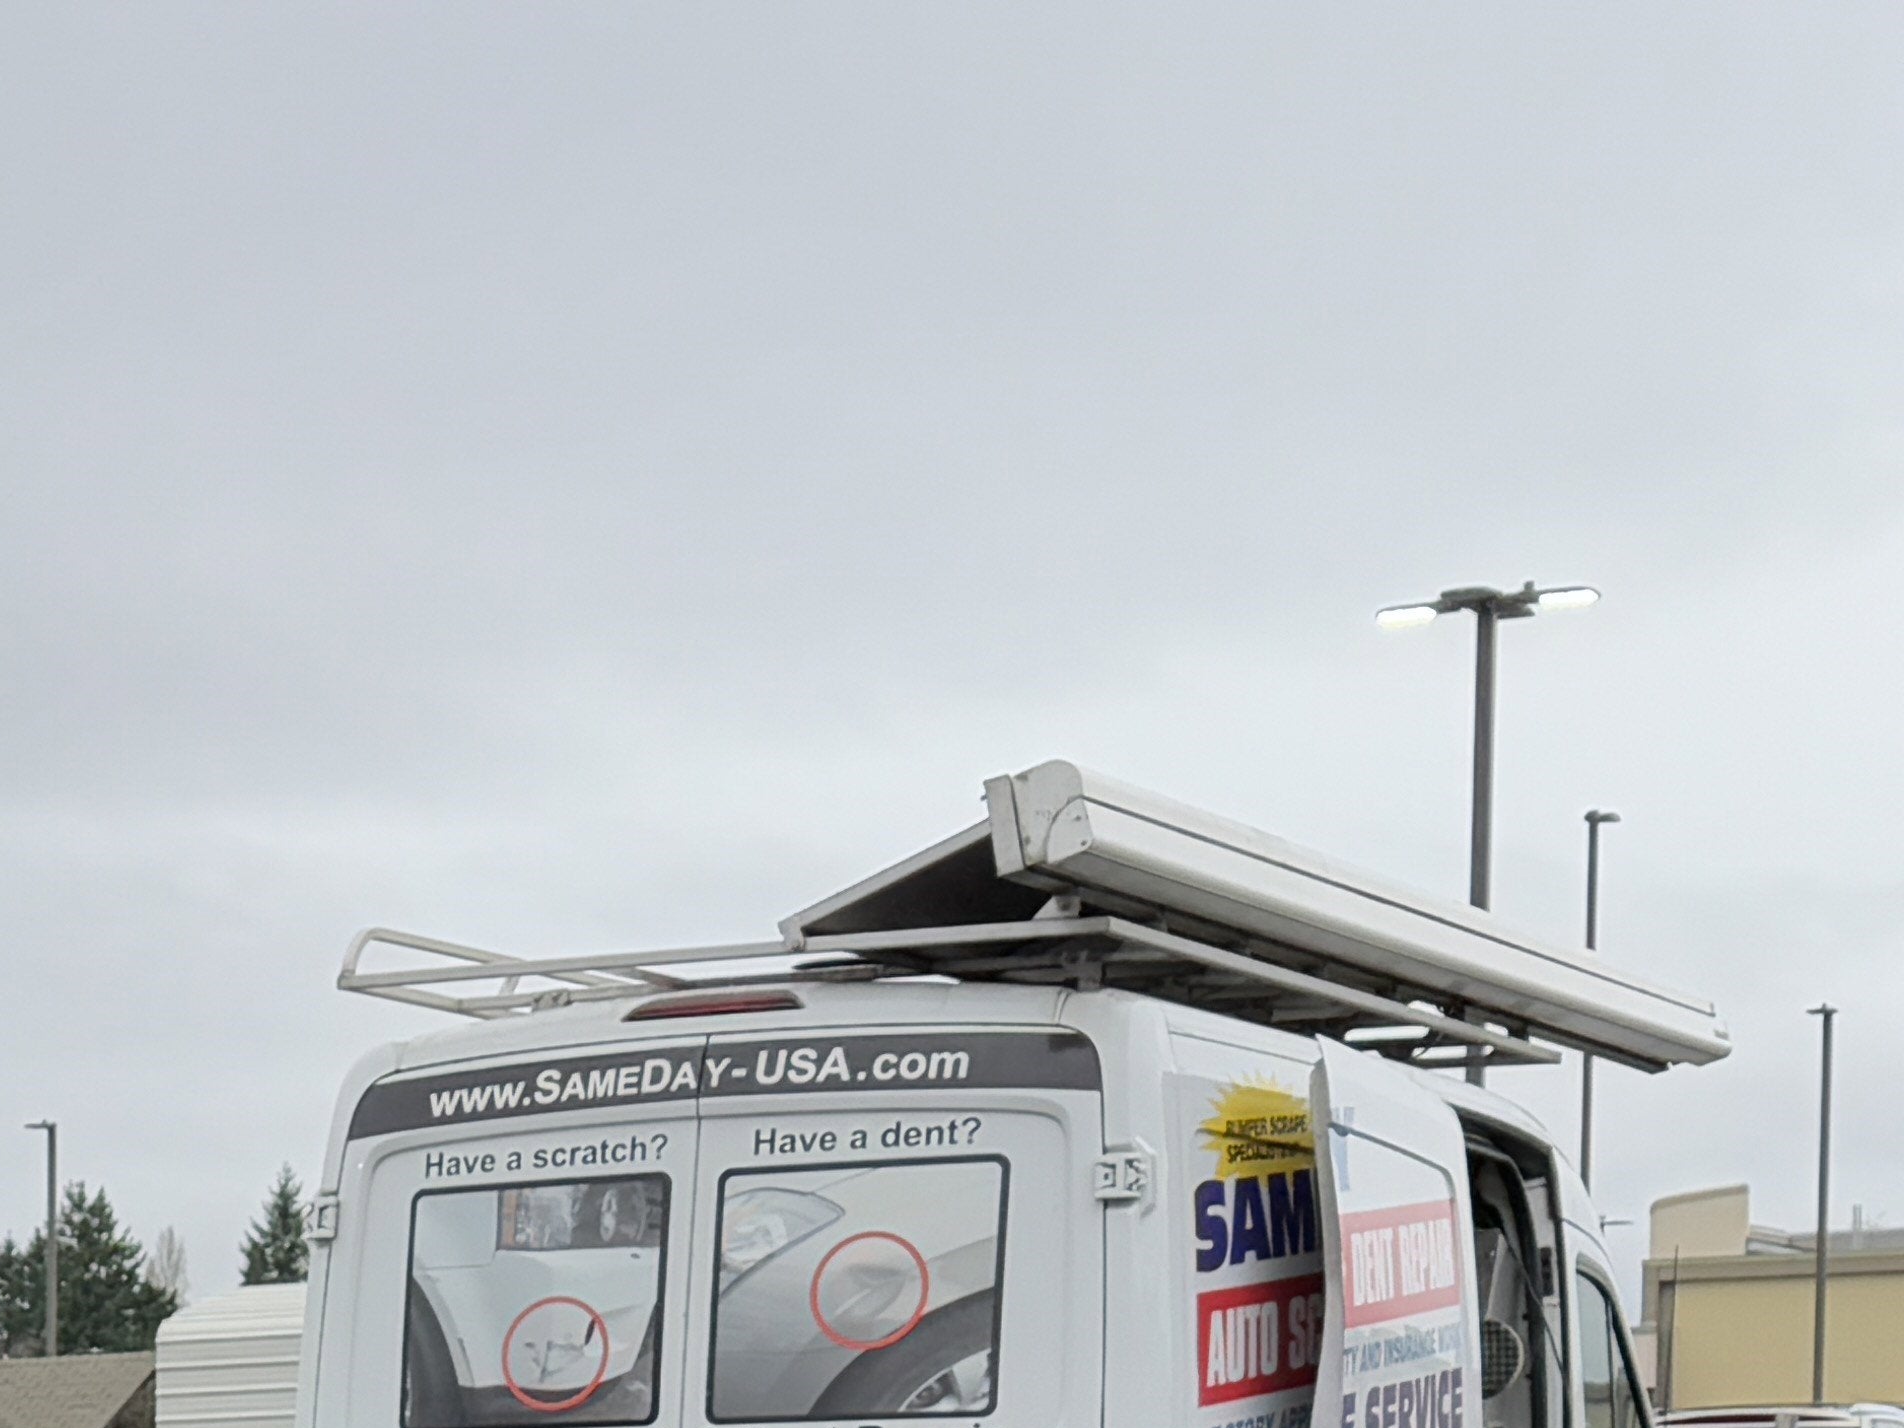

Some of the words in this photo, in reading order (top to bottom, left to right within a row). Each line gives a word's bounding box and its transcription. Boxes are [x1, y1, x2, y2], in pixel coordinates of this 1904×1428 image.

[425, 1151, 496, 1179] Have
[506, 1151, 522, 1171] a
[532, 1133, 669, 1169] scratch?
[754, 1128, 837, 1155] Have
[850, 1129, 867, 1149] a
[880, 1117, 982, 1147] dent?
[1350, 1226, 1395, 1307] DENT
[1398, 1217, 1455, 1297] REPAIR
[1207, 1302, 1280, 1388] AUTO
